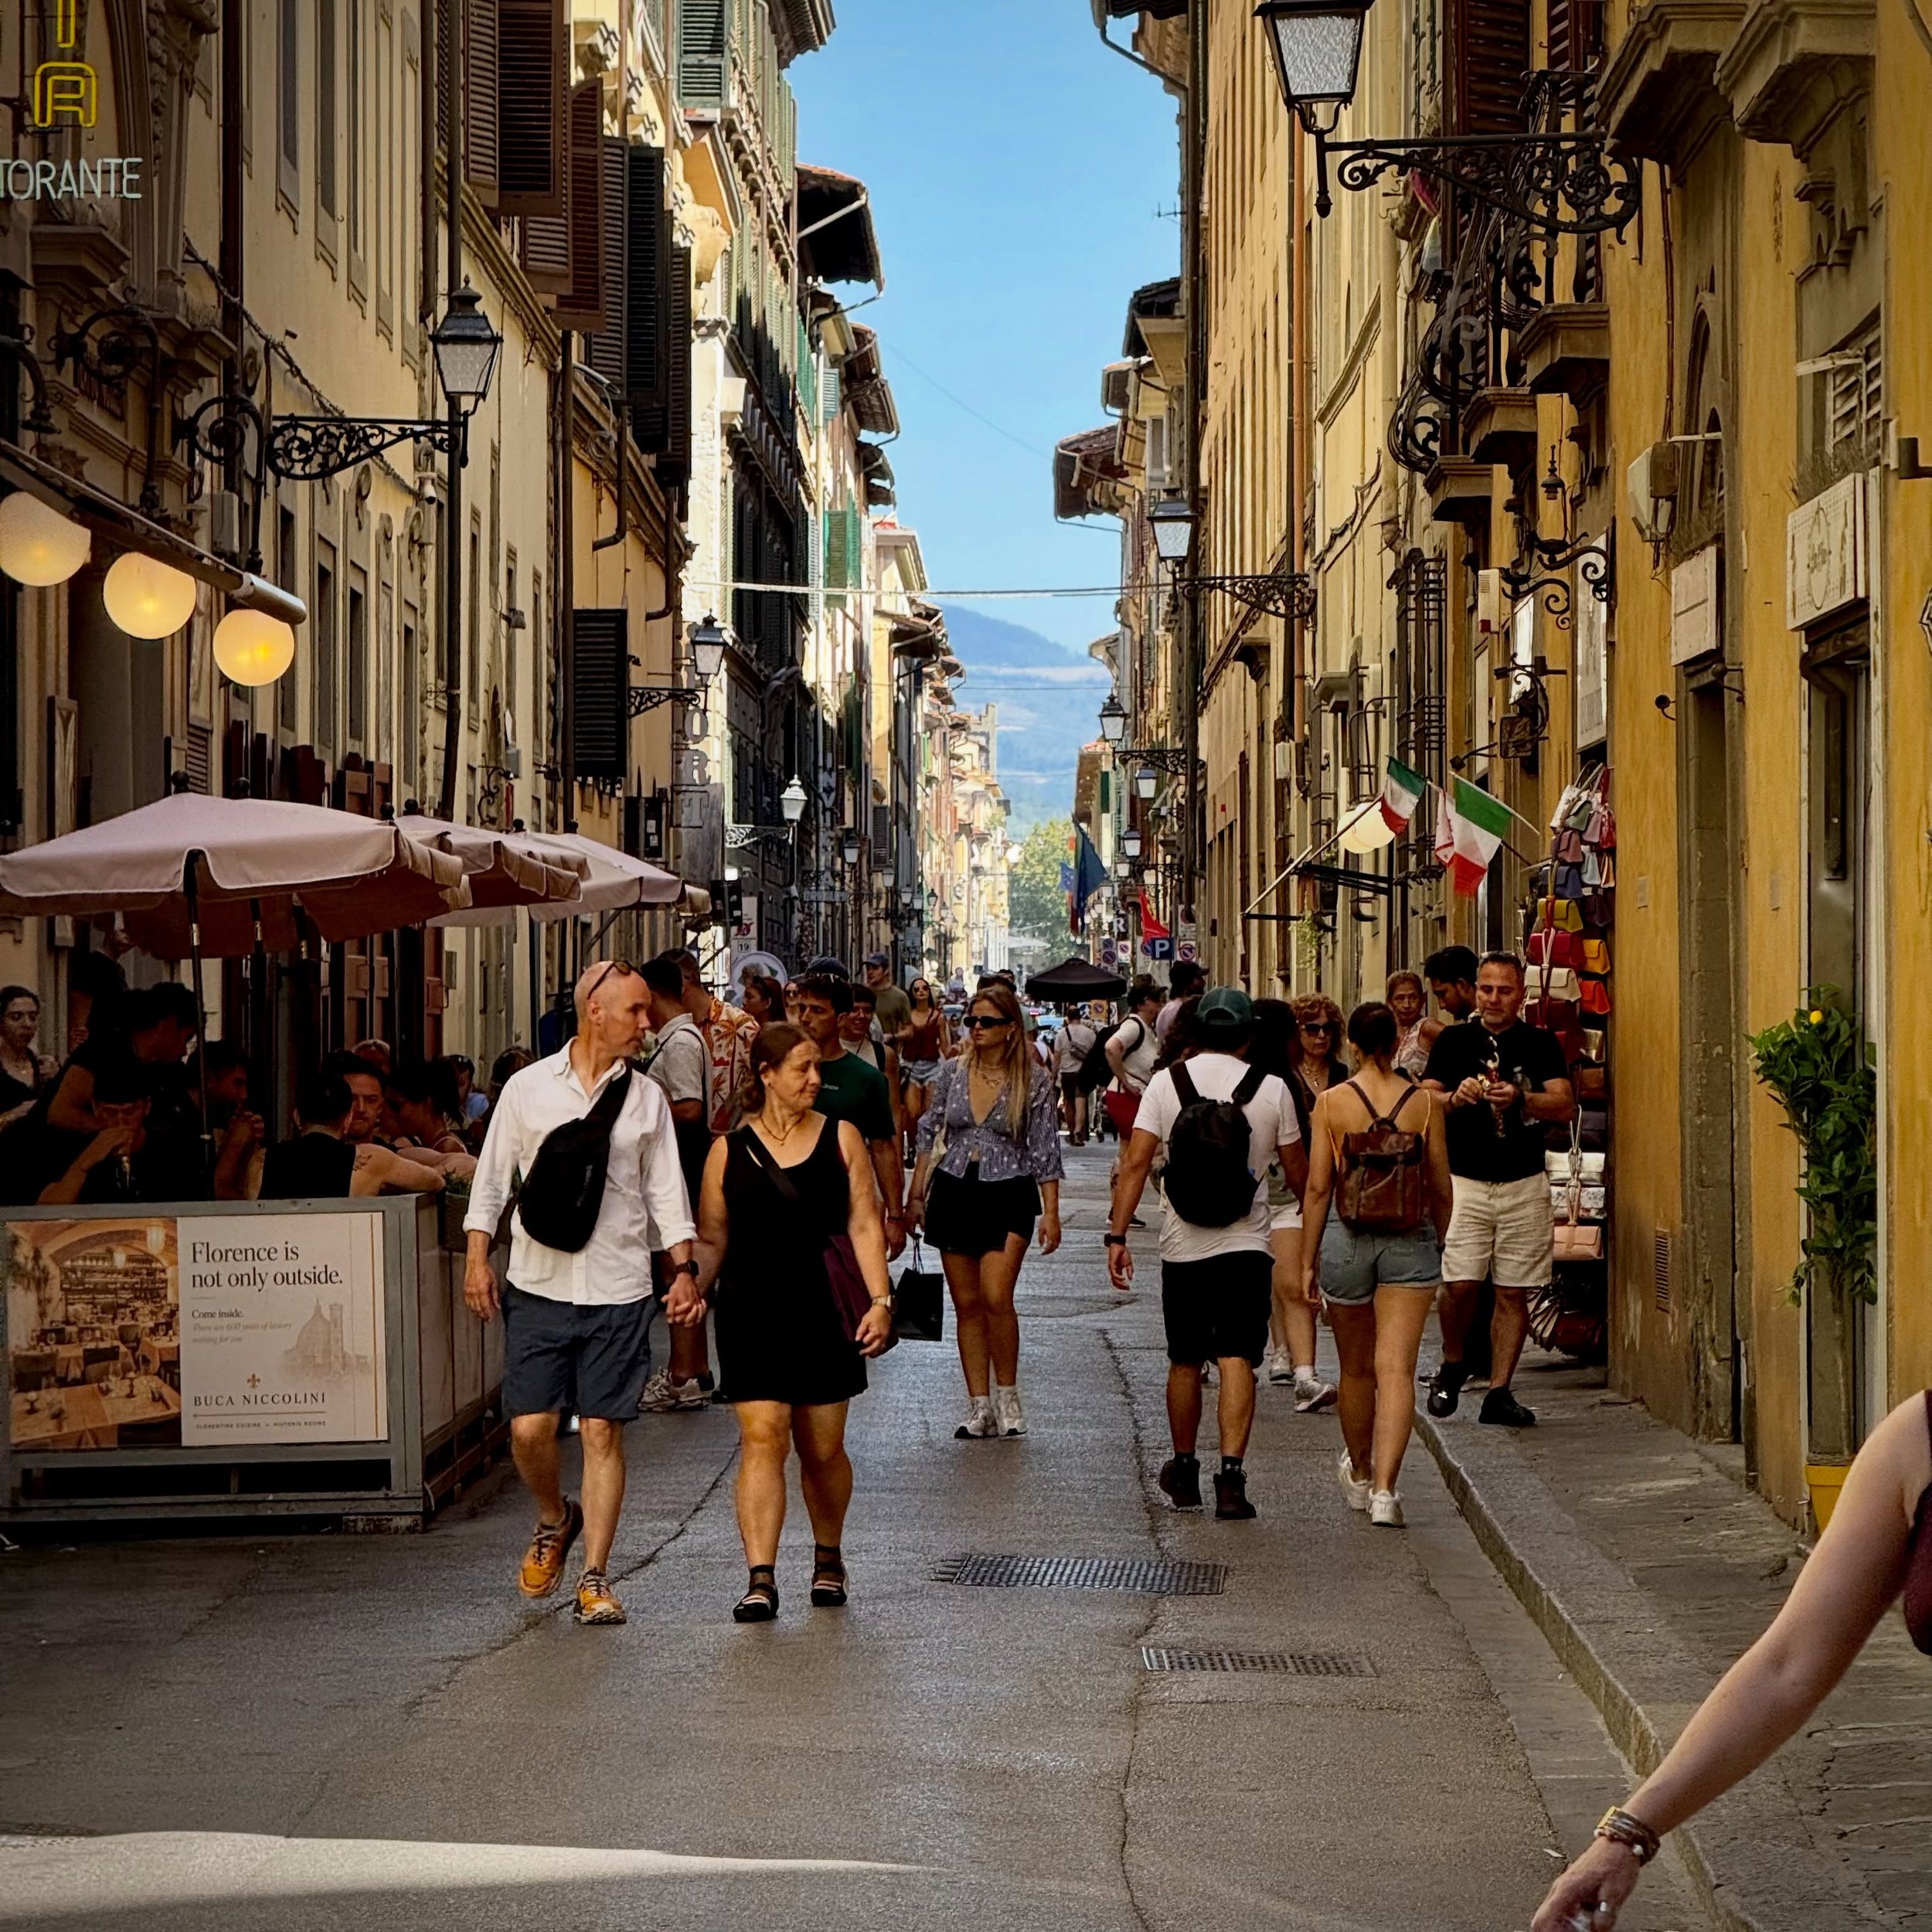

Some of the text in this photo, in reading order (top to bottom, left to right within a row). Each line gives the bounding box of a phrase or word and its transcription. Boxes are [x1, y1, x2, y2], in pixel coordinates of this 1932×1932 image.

[1155, 939, 1170, 958] P
[192, 1241, 299, 1264] Florence is
[192, 1264, 343, 1292] not only outside.
[192, 1309, 216, 1319] Come
[194, 1392, 325, 1406] BUCA NICCOLINI
